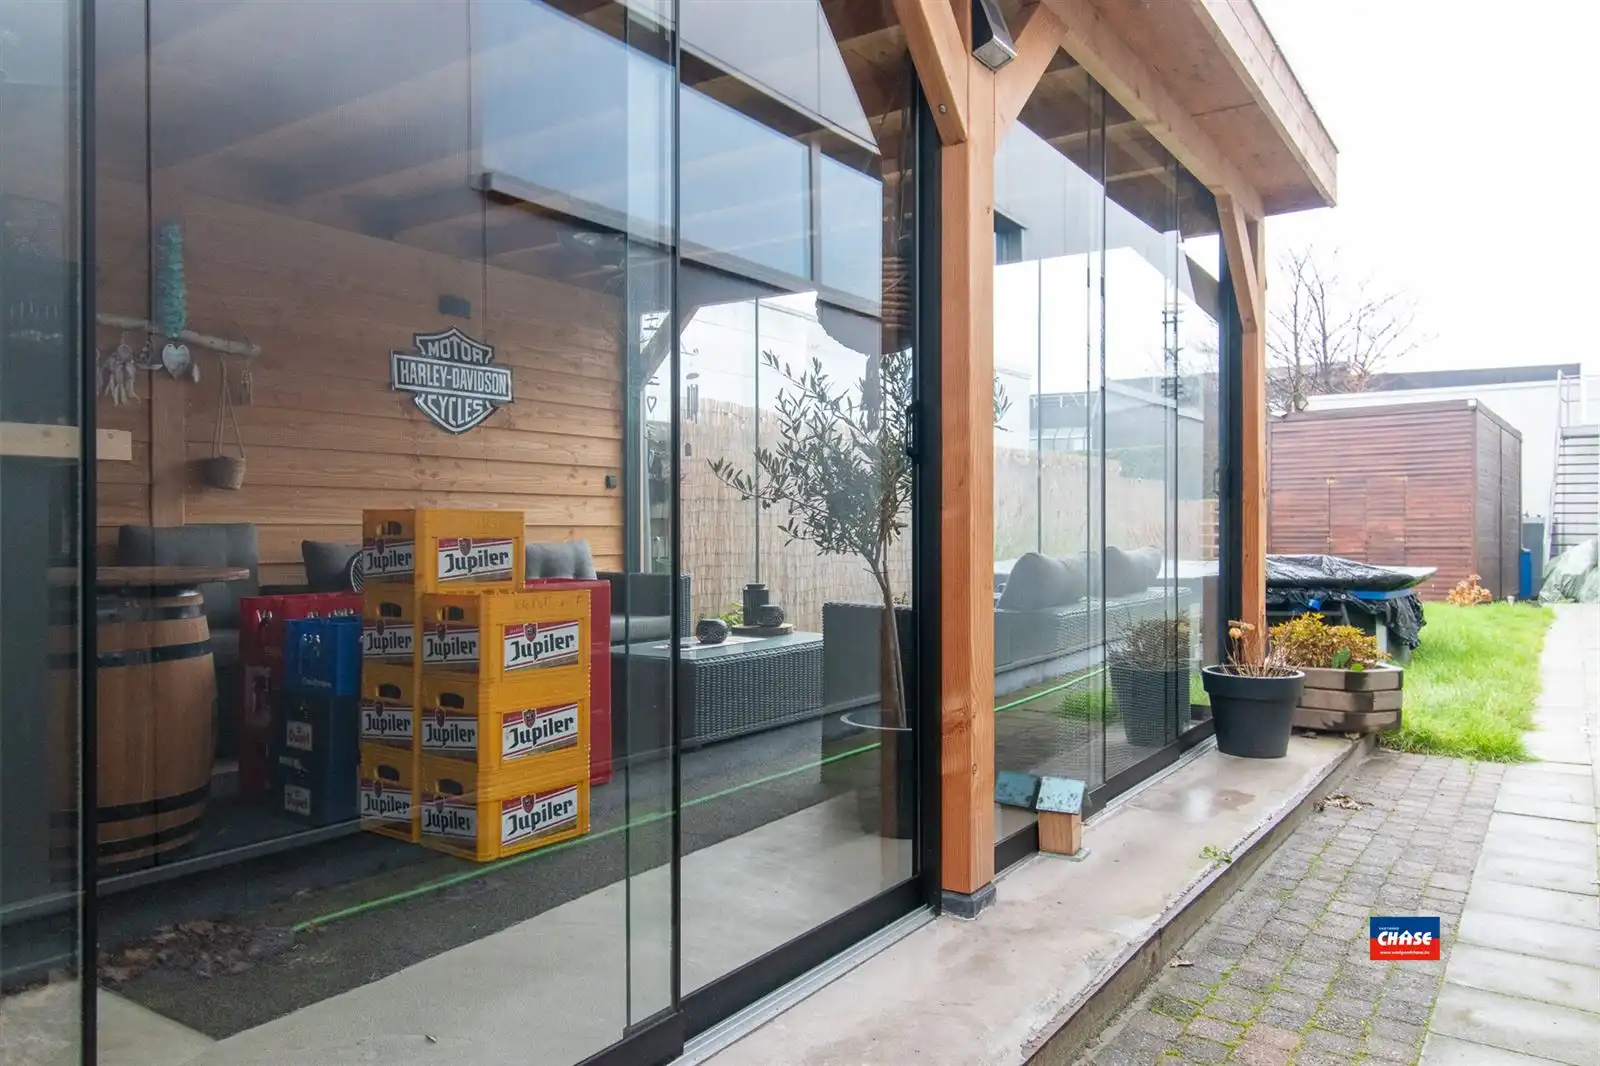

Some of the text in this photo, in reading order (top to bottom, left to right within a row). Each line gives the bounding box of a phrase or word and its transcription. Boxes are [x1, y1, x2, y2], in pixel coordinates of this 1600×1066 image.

[427, 335, 484, 364] MOTOR
[400, 360, 507, 395] HARLEY-DAVIDSON
[427, 394, 484, 427] CYCLES
[366, 549, 412, 572] Jupiler
[444, 550, 509, 574] Jupiler
[367, 631, 412, 653] Jupiler
[426, 638, 477, 661] Jupiler
[510, 631, 575, 662] Jupiler
[365, 713, 412, 734] Jupiler
[425, 724, 476, 746] Jupiler
[508, 715, 574, 750] Jupiler
[507, 798, 574, 835] Jupiler
